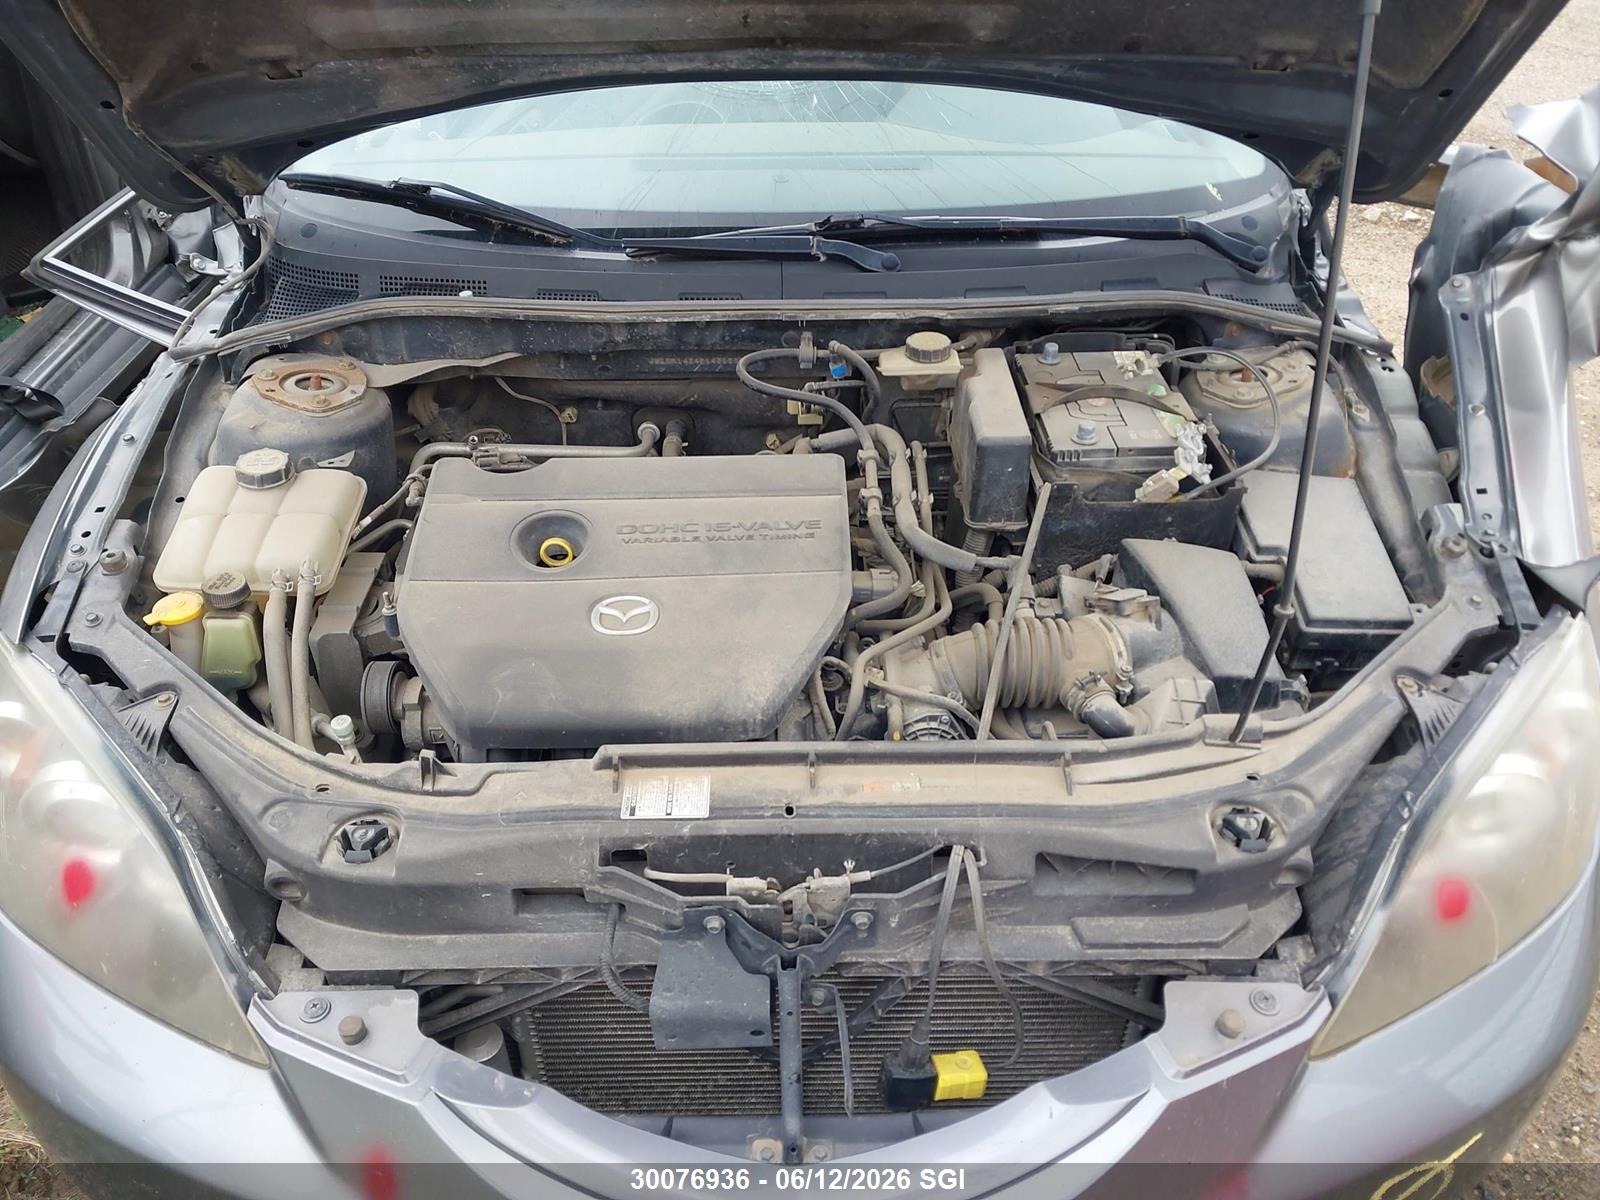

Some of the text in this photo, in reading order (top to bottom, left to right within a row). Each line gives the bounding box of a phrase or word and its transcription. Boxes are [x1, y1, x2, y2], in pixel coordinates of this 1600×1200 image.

[616, 519, 822, 535] DOHC 16-VALVE
[621, 532, 816, 545] VARIABLE VALVE TIMING
